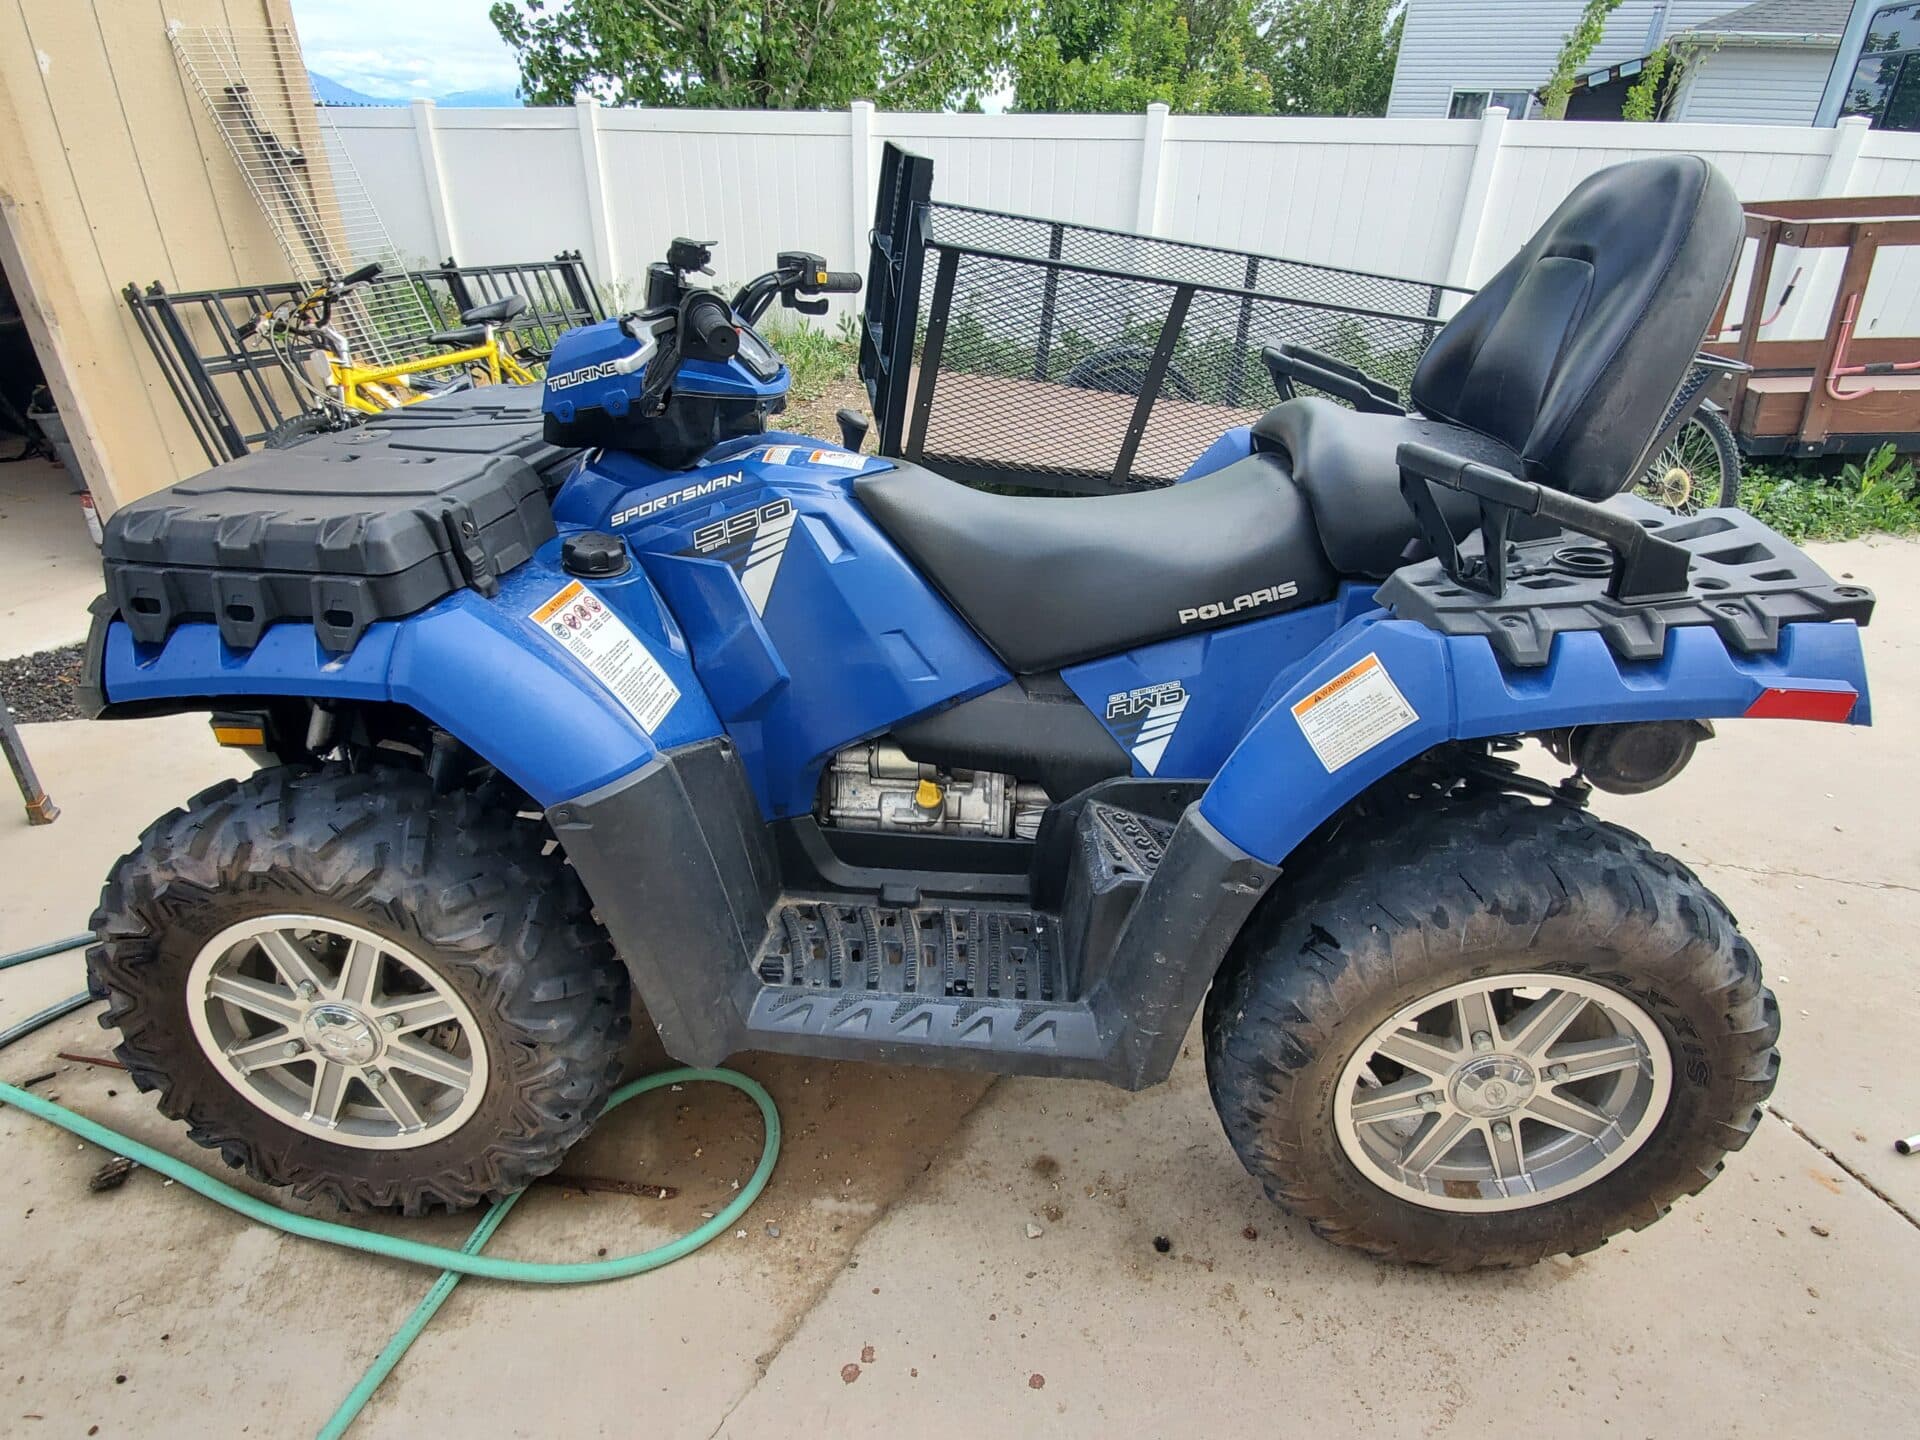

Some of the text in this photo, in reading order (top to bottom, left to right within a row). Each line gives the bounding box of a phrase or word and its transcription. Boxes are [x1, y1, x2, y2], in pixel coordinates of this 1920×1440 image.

[611, 471, 743, 527] SPORTSMAN
[693, 498, 793, 550] 550
[1178, 581, 1298, 624] POLARIS
[1108, 680, 1181, 703] ON DEMAND
[1321, 671, 1357, 697] WARNING
[1106, 687, 1186, 719] AWD
